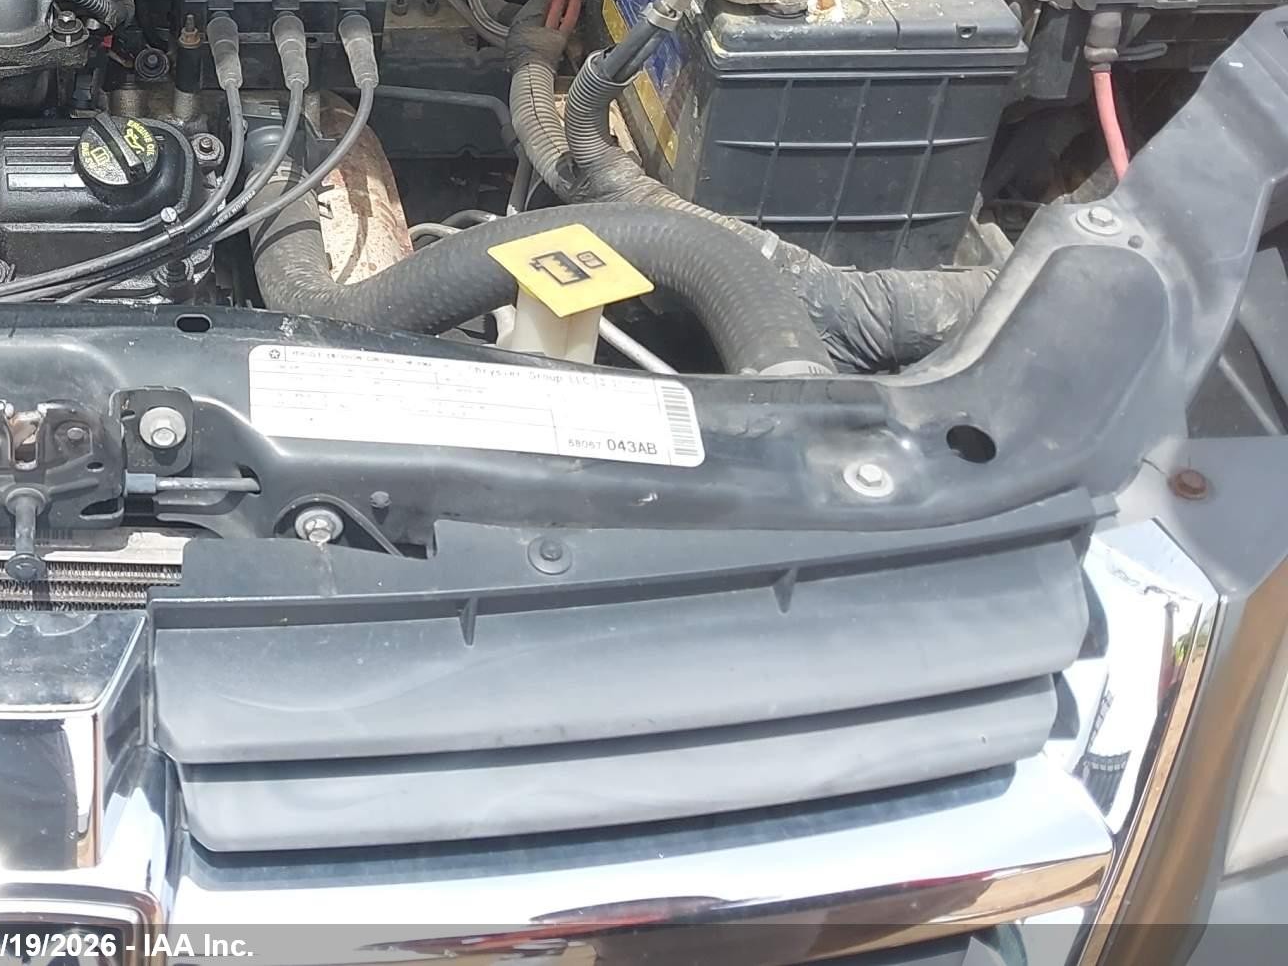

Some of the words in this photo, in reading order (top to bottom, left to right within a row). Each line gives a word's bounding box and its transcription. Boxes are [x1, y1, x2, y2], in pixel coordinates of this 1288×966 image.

[126, 119, 153, 143] ENGINE
[146, 143, 155, 156] OIL
[607, 439, 657, 455] 043AB
